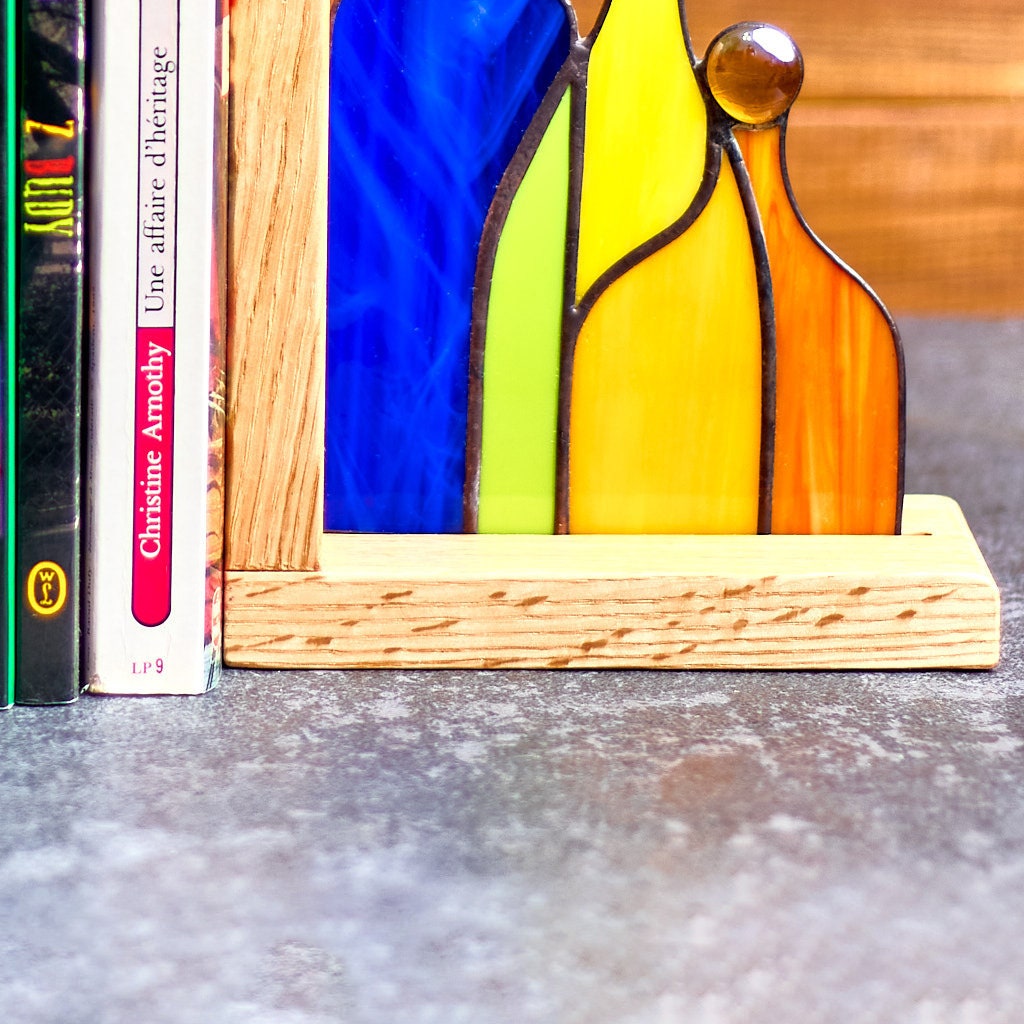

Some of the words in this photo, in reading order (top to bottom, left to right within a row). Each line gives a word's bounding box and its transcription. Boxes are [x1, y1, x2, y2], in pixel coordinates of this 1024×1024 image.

[144, 46, 176, 168] d'héritage
[23, 155, 75, 238] BUDY
[143, 178, 167, 255] affaire
[144, 264, 166, 314] Une
[140, 341, 172, 442] Arnothy
[138, 450, 163, 560] Christine
[132, 662, 152, 674] LP
[155, 658, 164, 674] 9
